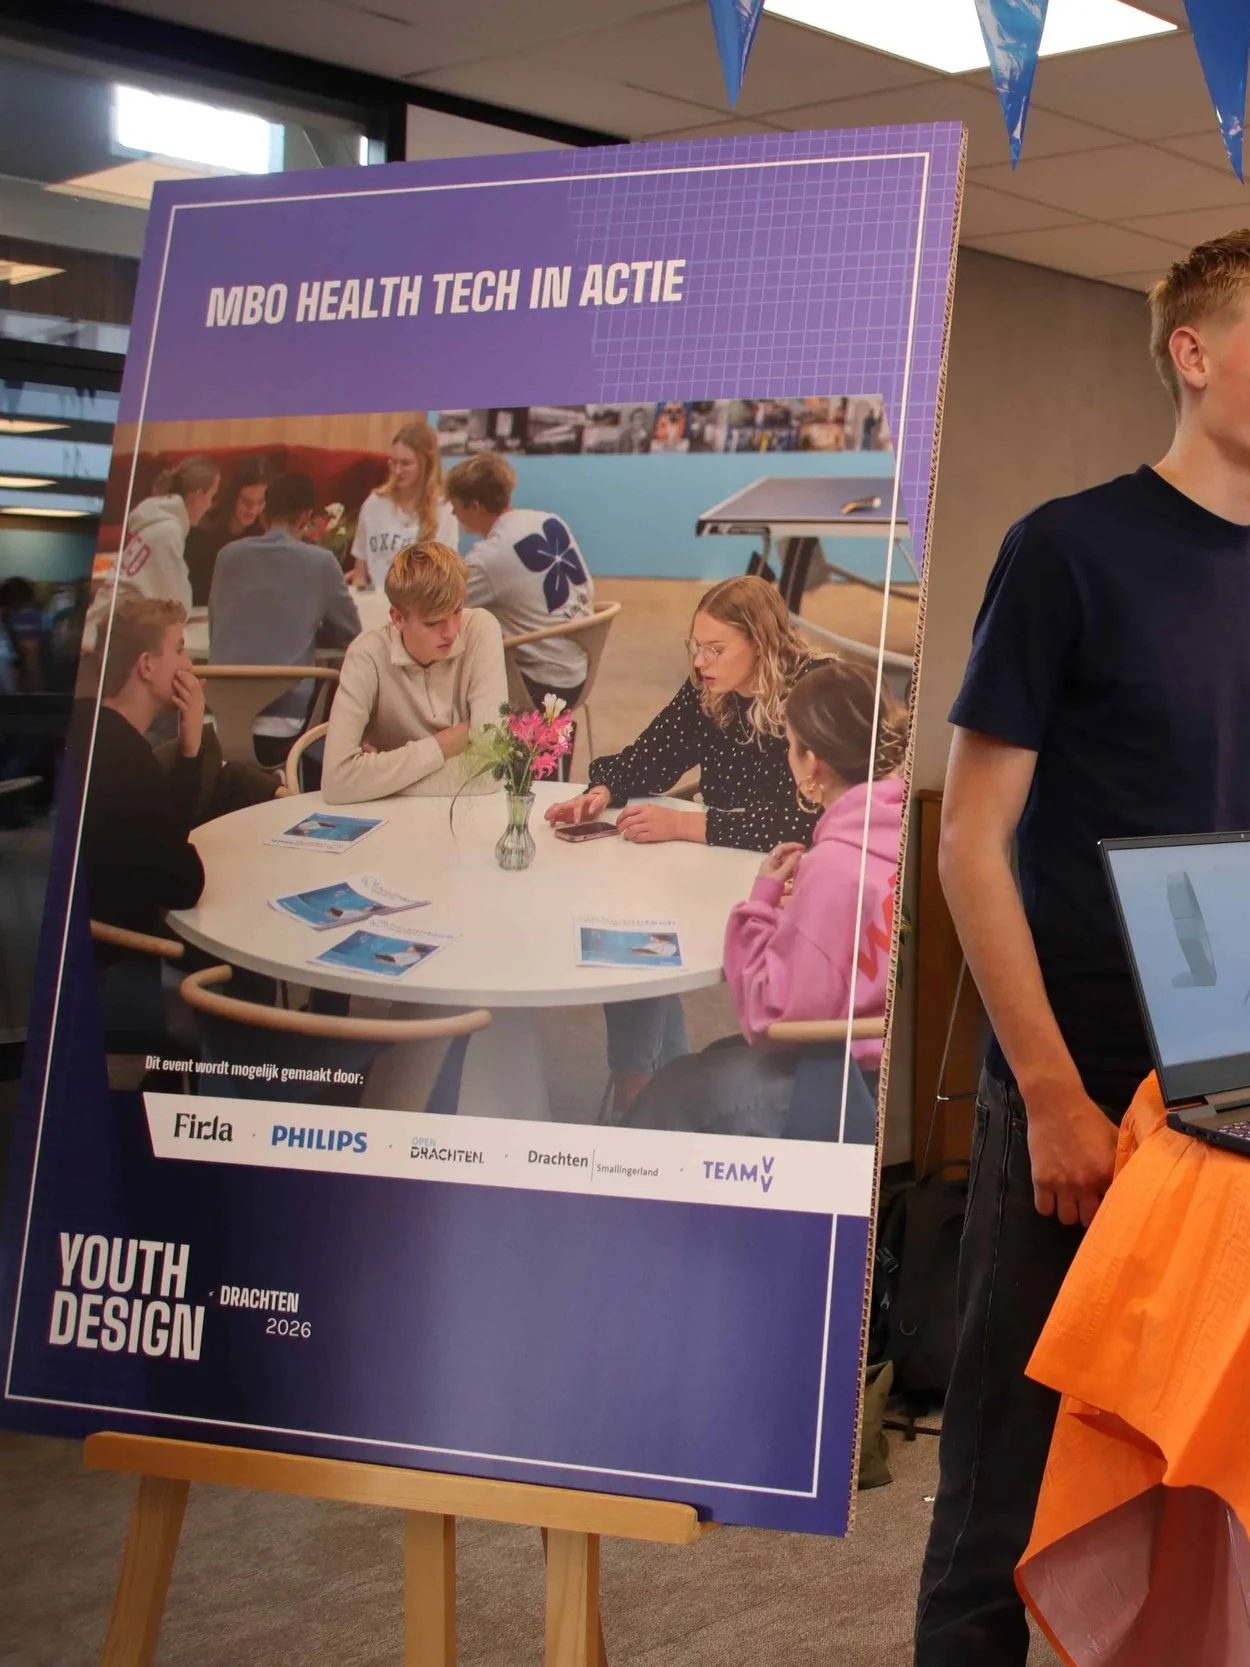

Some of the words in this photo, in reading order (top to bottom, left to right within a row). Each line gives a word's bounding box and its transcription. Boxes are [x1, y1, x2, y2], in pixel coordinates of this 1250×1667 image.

[206, 283, 288, 327] MBO
[296, 275, 423, 322] HEALTH
[432, 269, 521, 315] TECH
[529, 266, 572, 309] IN
[579, 259, 686, 306] ACTIE
[145, 1054, 161, 1071] Dit
[162, 1058, 194, 1073] event
[195, 1059, 230, 1075] wordt
[230, 1062, 279, 1082] mogelijk
[280, 1065, 332, 1084] gemaakt
[333, 1067, 364, 1086] door:
[271, 1124, 368, 1153] PHILIPS
[411, 1136, 437, 1148] OPEN
[527, 1149, 589, 1169] Drachten
[596, 1162, 659, 1178] Smallingerland
[60, 1231, 190, 1299] YOUTH
[219, 1285, 300, 1313] DRACHTEN
[49, 1290, 205, 1361] DESIGN
[265, 1317, 312, 1338] 2026
